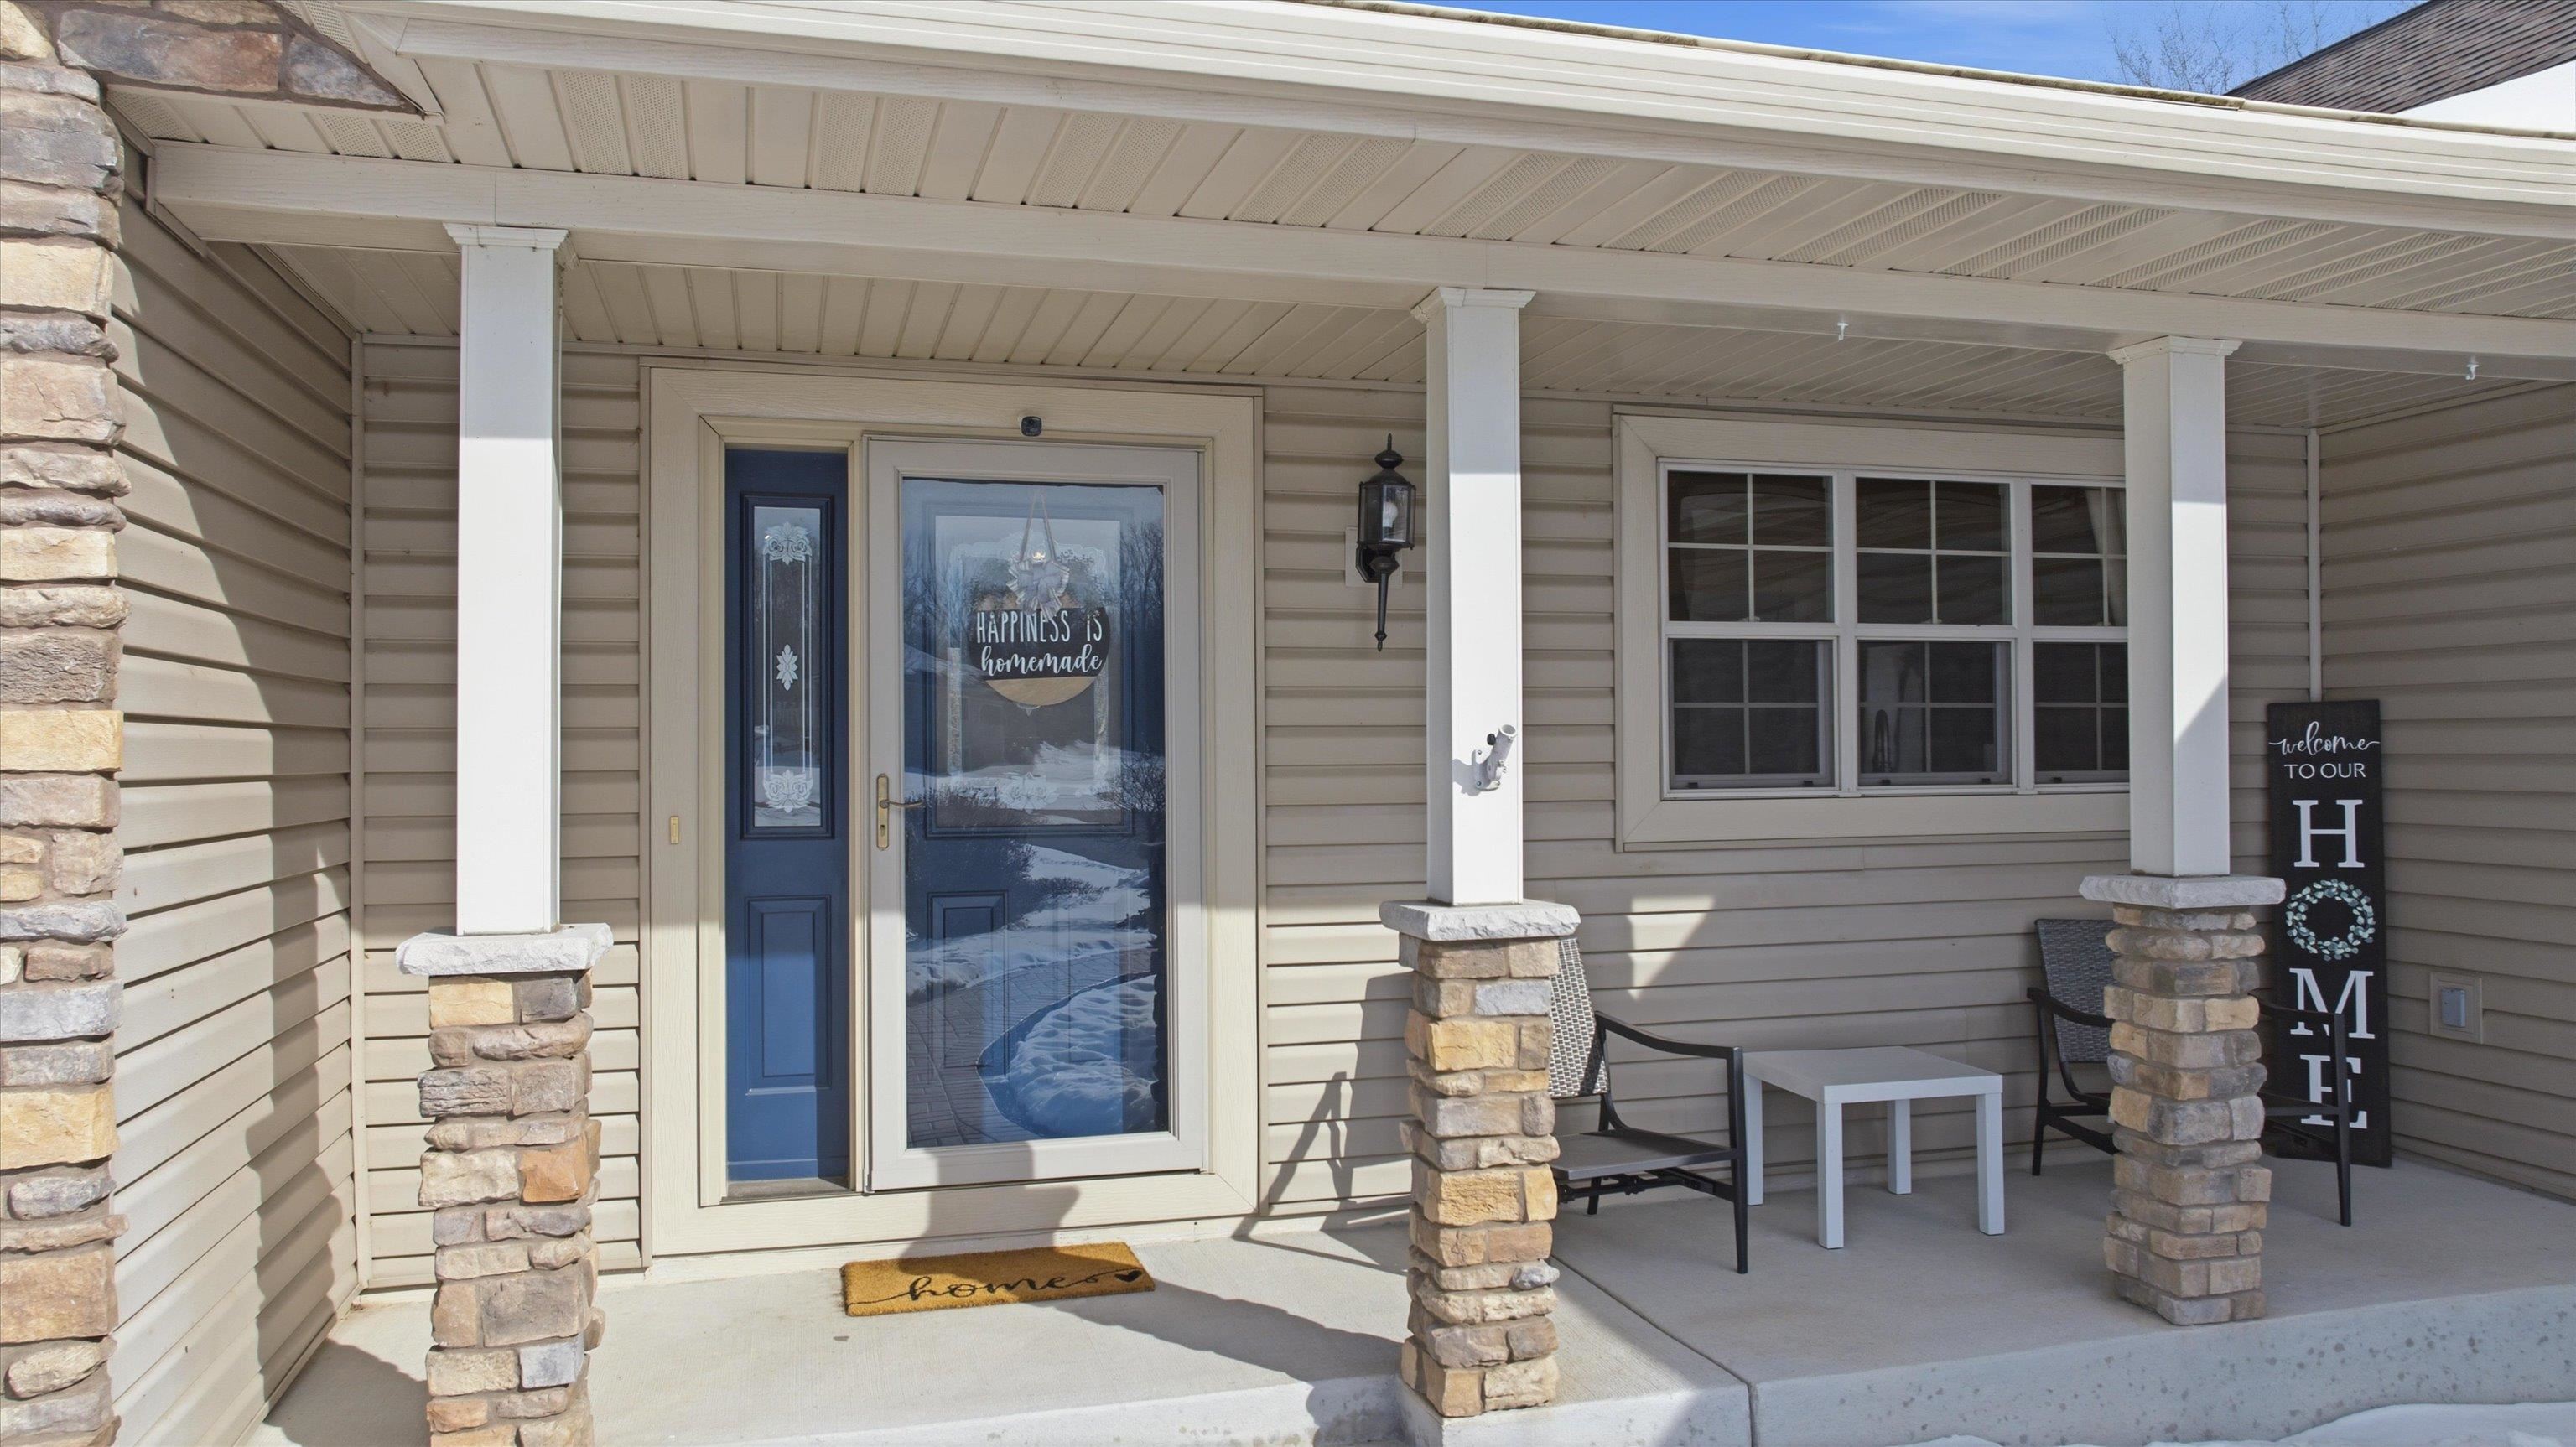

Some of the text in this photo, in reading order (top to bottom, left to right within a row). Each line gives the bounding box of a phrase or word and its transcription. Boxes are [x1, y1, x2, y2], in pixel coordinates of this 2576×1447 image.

[976, 610, 1103, 643] HAPPINESS IS
[981, 643, 1103, 676] homemade
[2268, 721, 2381, 755] welcome
[2284, 762, 2366, 780] TO OUR
[849, 1272, 1105, 1303] home
